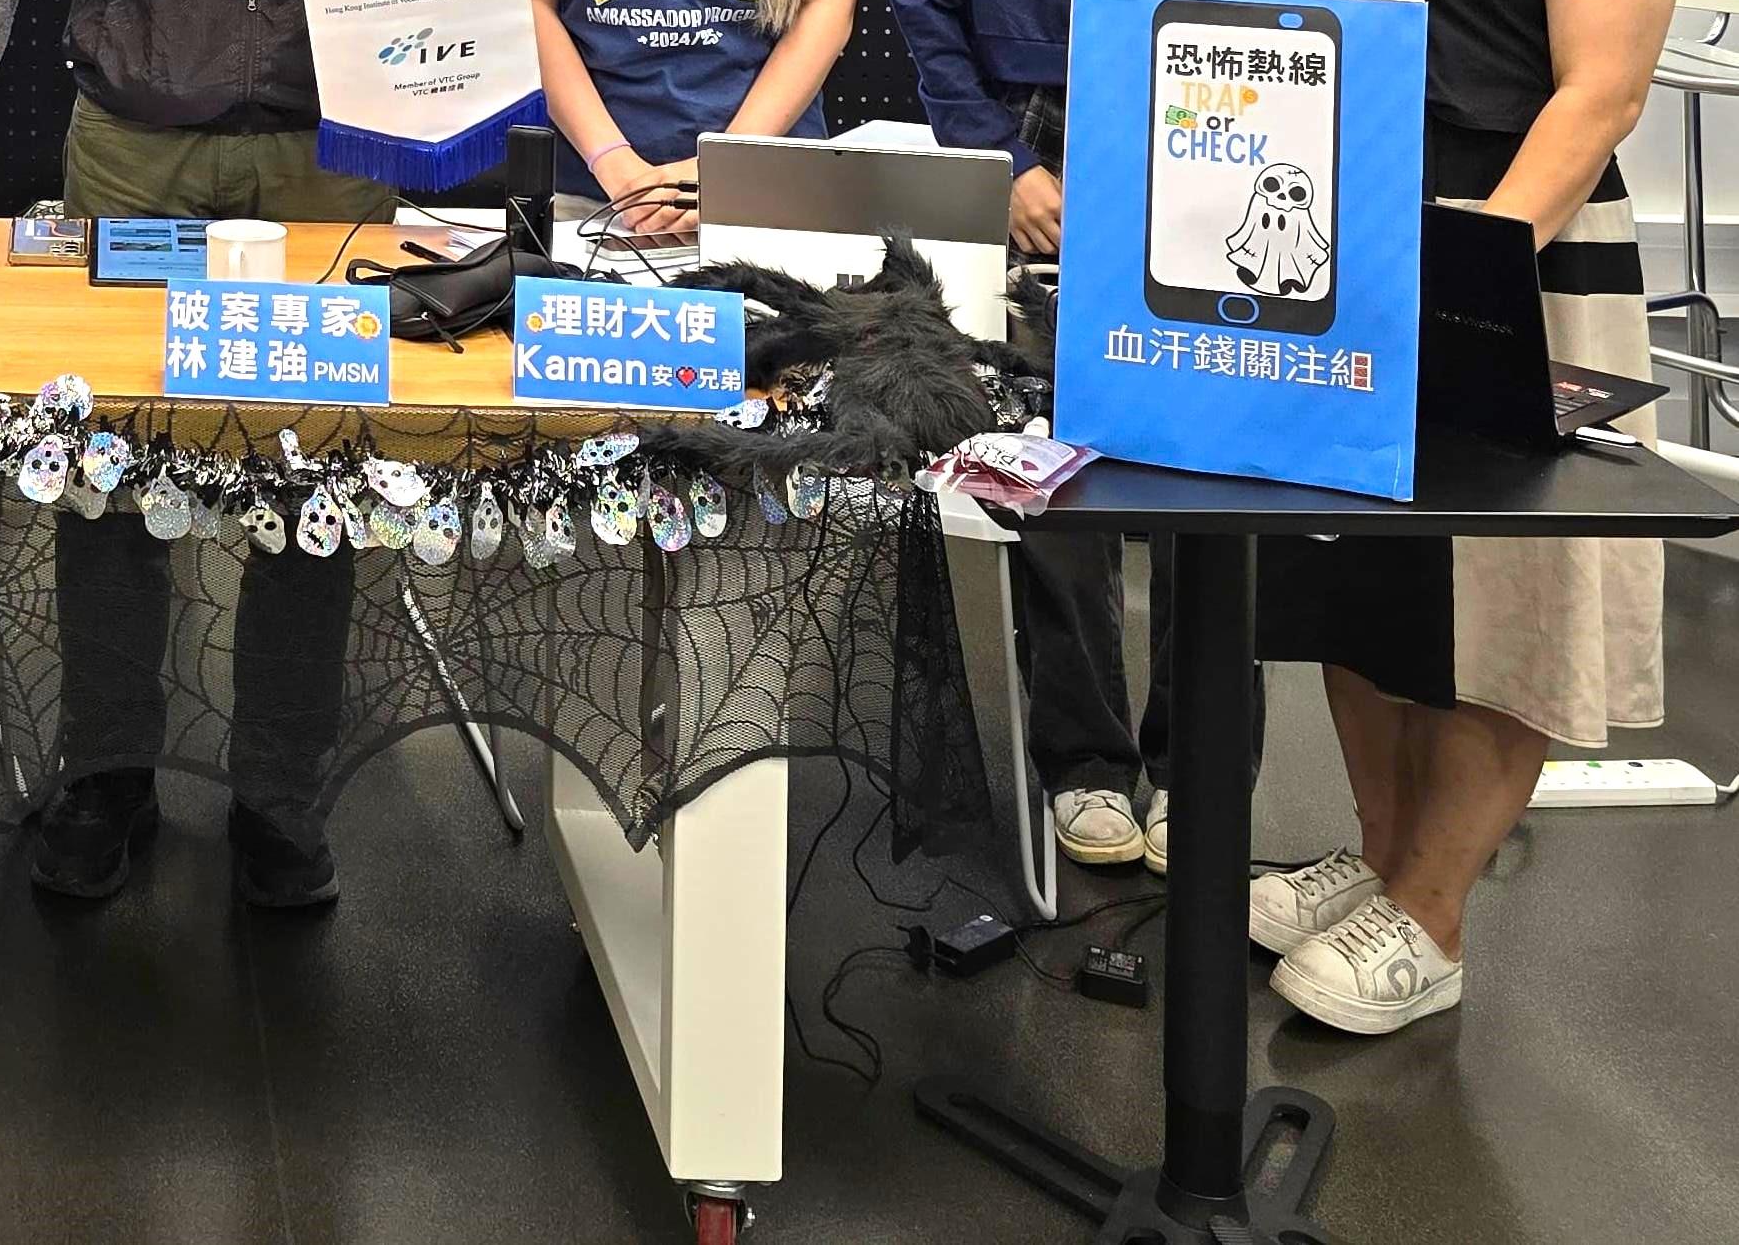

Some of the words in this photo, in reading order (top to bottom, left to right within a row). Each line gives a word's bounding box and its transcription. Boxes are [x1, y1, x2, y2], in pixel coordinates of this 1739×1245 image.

[344, 3, 362, 13] Kong
[586, 6, 701, 29] AMBASSADOR
[394, 80, 427, 92] Member
[428, 78, 437, 86] of
[438, 75, 455, 84] VTC
[456, 72, 481, 82] Group
[1166, 43, 1328, 87] 恐怖熱線
[412, 89, 429, 97] VTC
[1206, 116, 1235, 133] or
[1167, 128, 1268, 166] CHECK
[169, 289, 361, 338] 破案專家
[541, 294, 717, 344] 理財大使
[167, 335, 308, 384] 林建強
[314, 361, 380, 385] PMSM
[516, 342, 647, 387] Kaman
[1104, 324, 1375, 392] 血汗錢關注組
